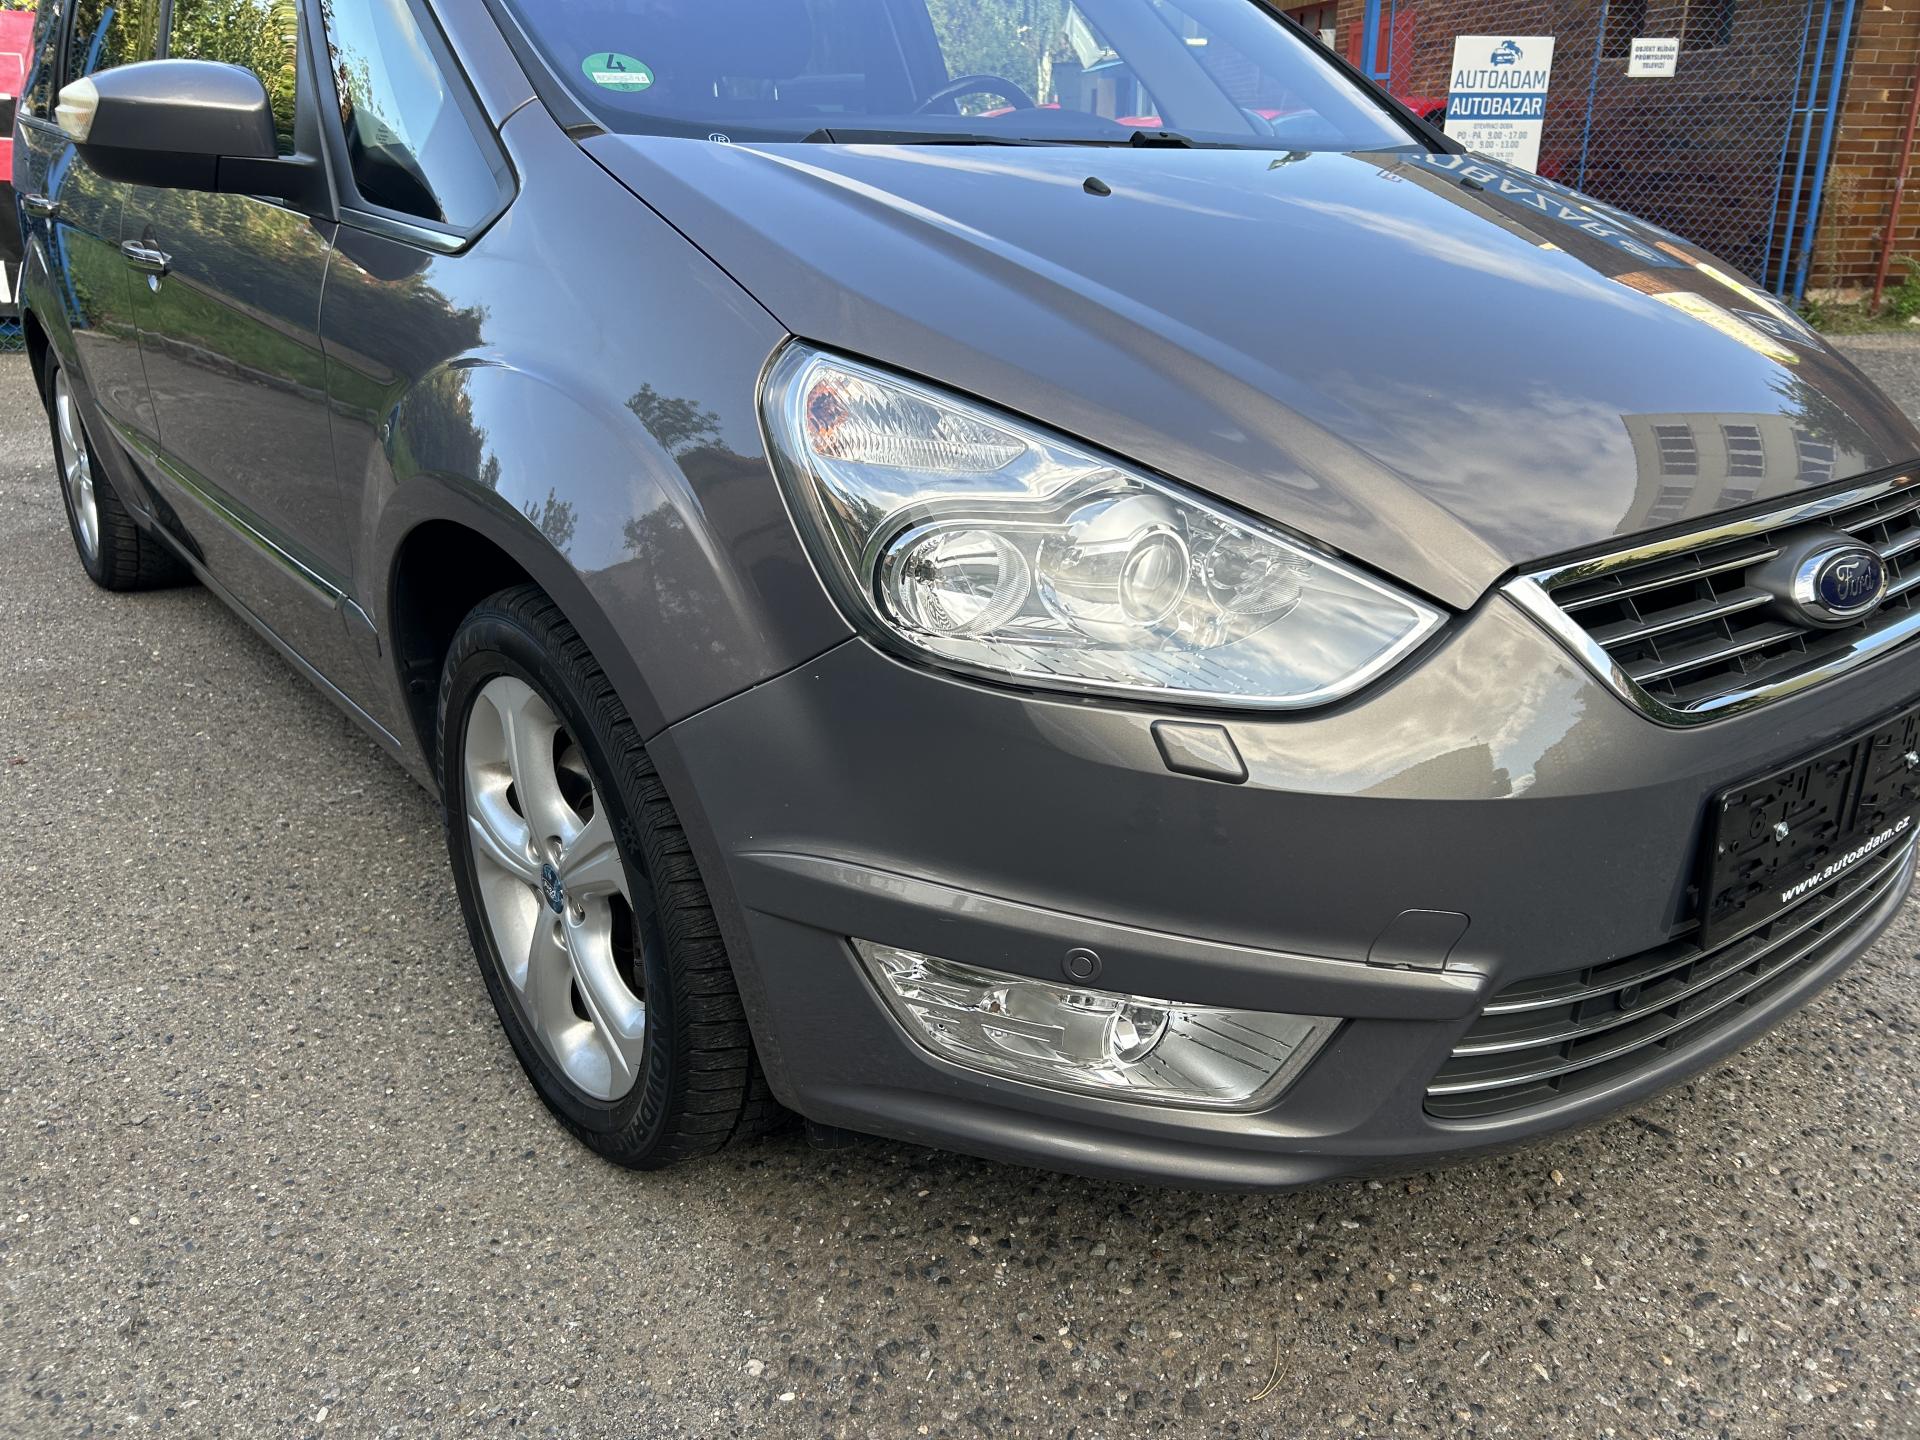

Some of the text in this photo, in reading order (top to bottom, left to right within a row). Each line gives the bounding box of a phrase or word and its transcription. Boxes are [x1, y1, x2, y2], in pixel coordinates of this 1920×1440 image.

[607, 54, 626, 72] 4
[1454, 70, 1547, 89] AUTOADAM
[1450, 97, 1542, 115] AUTOBAZAR
[1457, 131, 1467, 139] PO
[1487, 131, 1502, 139] 9.00
[1508, 131, 1528, 139] 17.00
[1479, 140, 1494, 148] 9.00
[1500, 140, 1519, 148] 13.00
[1836, 561, 1874, 600] Ford
[1782, 816, 1911, 903] www.autoadam.cz
